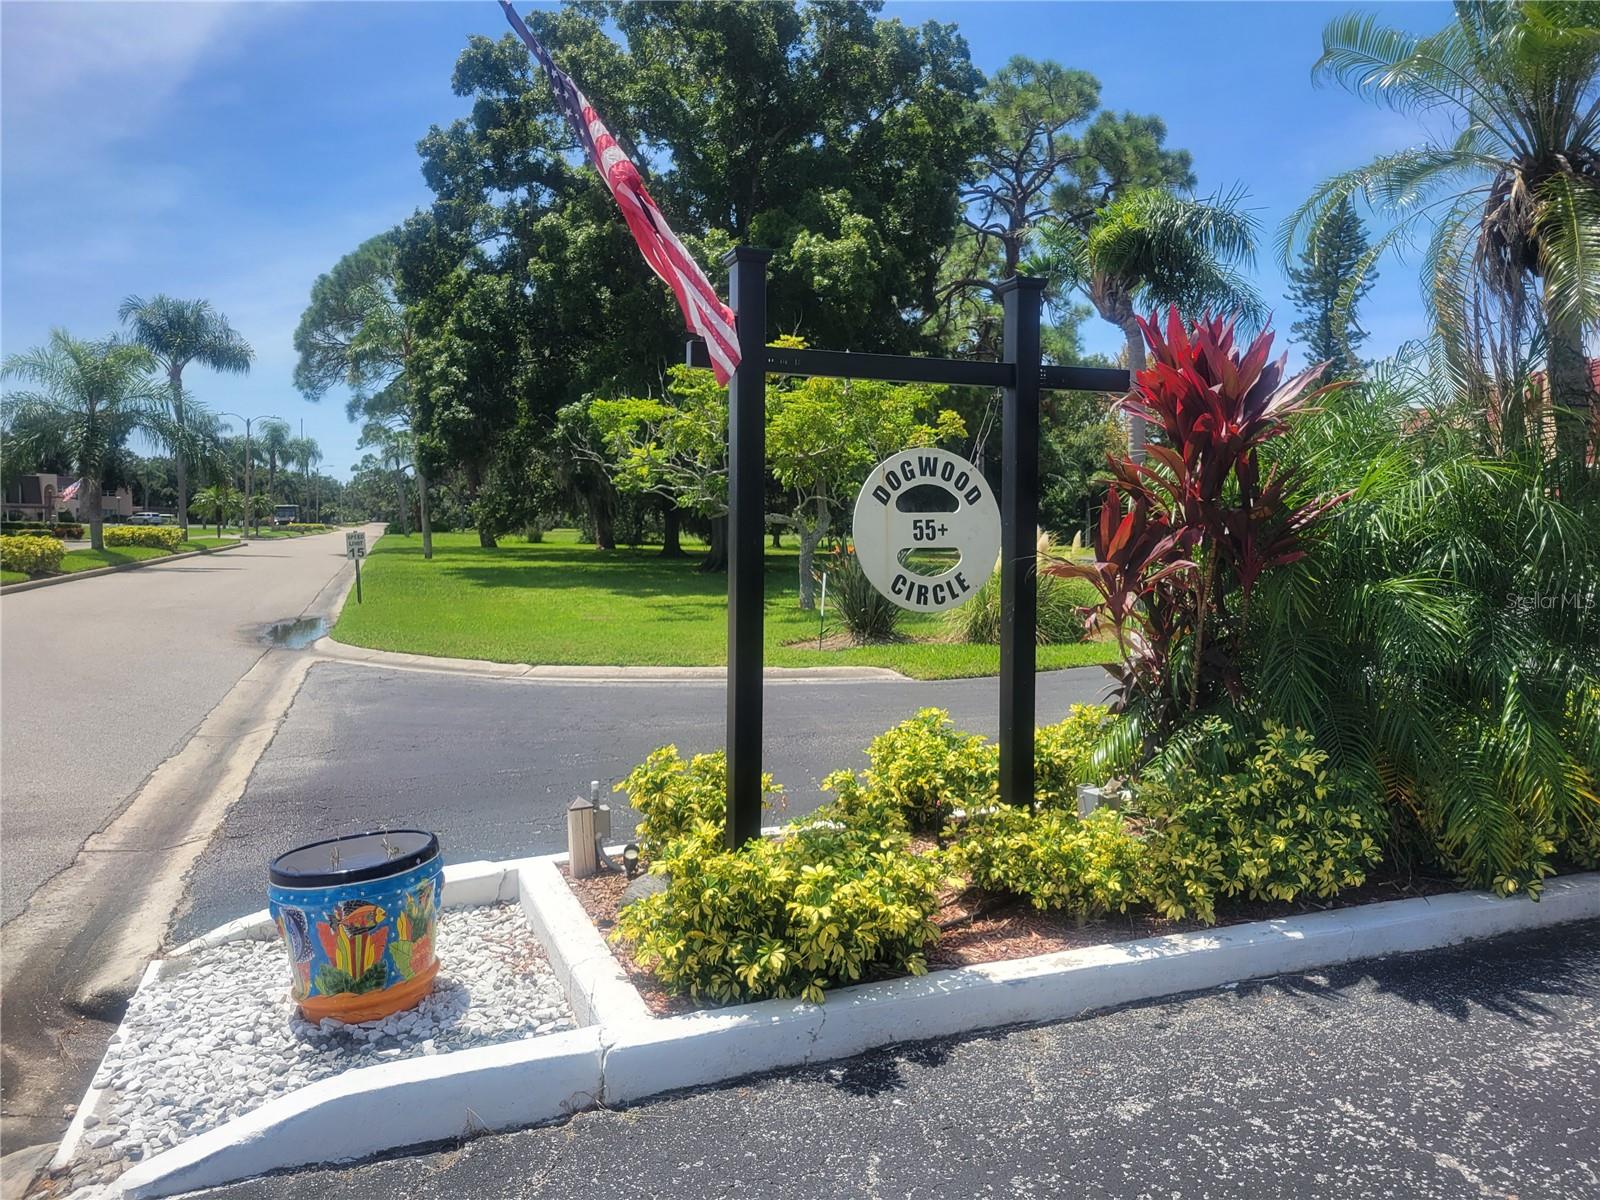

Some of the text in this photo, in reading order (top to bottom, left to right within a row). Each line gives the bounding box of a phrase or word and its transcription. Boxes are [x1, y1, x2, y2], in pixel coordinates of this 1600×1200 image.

[872, 456, 982, 506] DOGWOOD
[913, 520, 948, 541] 55+
[349, 548, 364, 558] 15
[890, 571, 970, 605] CIRCLE
